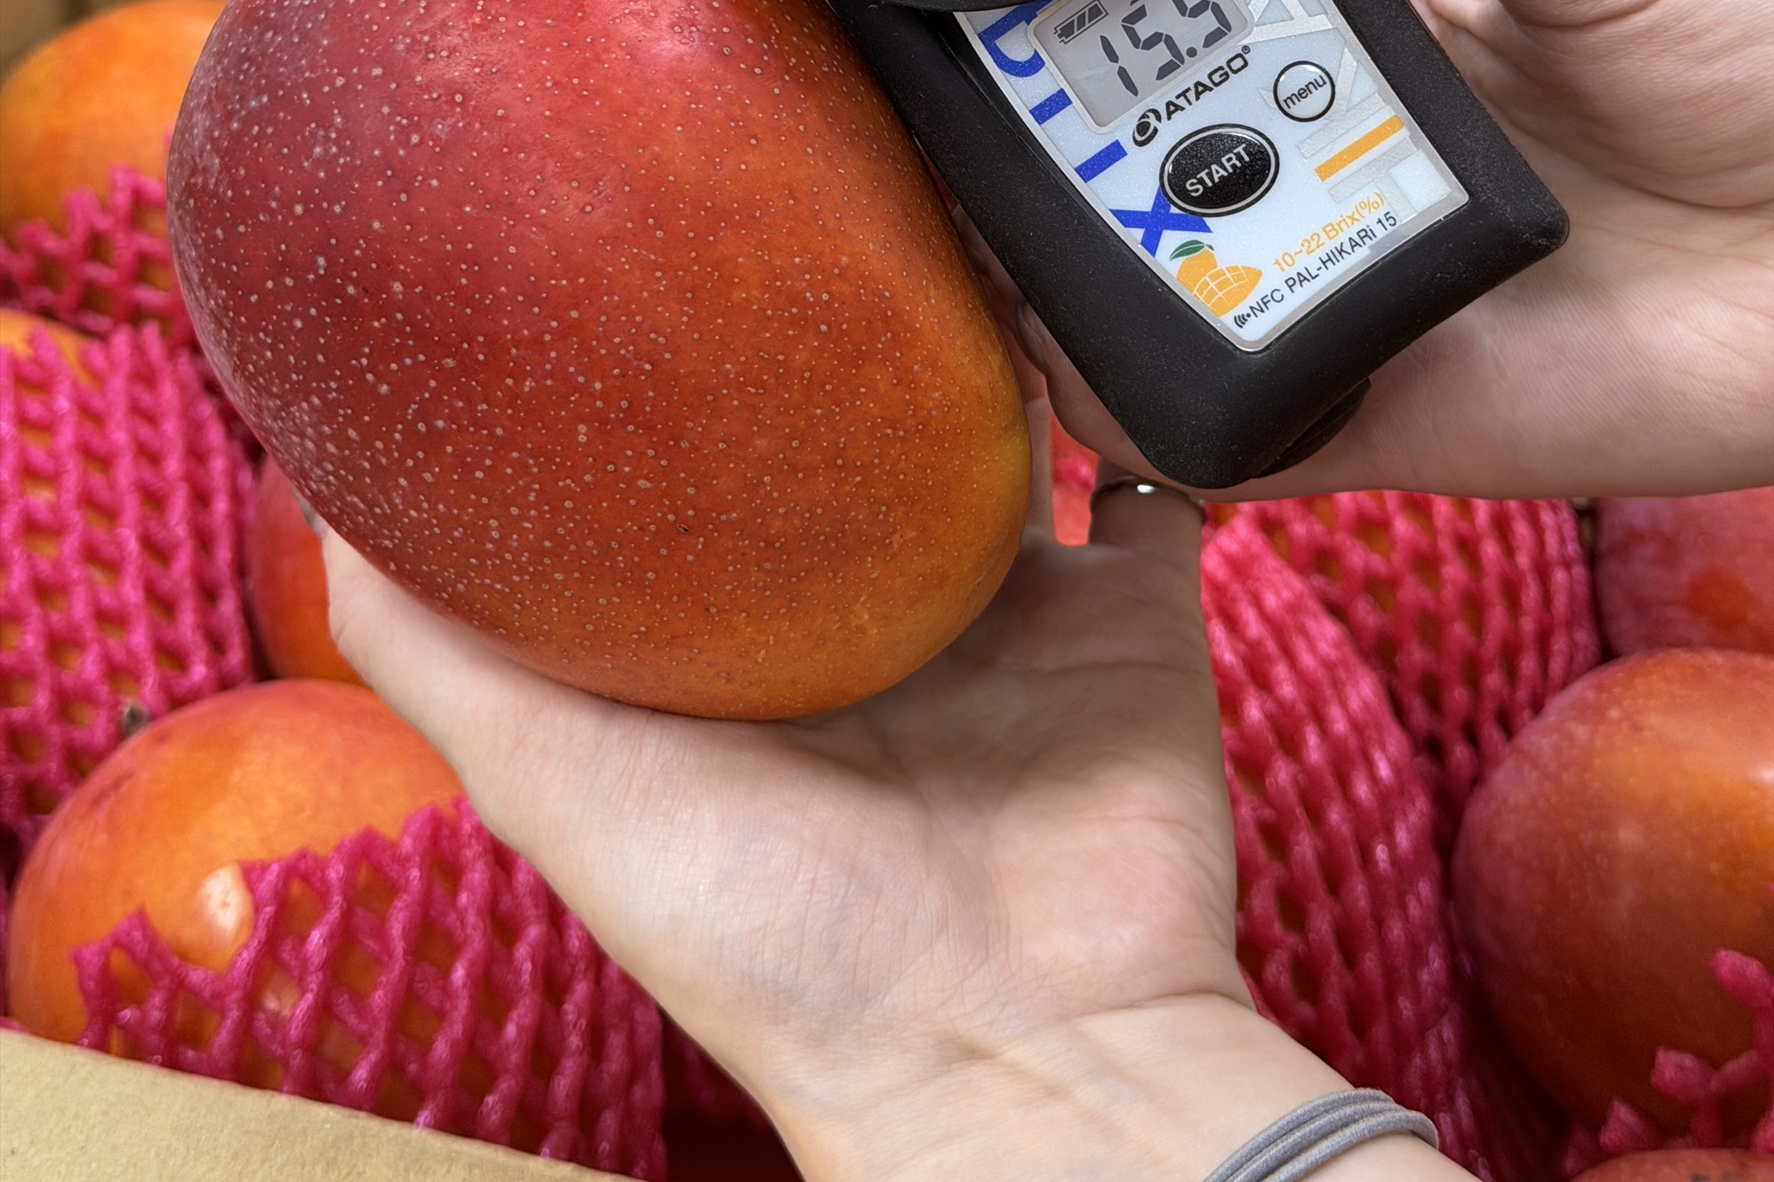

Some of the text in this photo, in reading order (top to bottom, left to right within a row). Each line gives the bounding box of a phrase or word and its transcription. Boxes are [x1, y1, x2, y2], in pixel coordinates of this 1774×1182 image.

[1283, 76, 1328, 110] menu
[1185, 145, 1251, 198] START
[1323, 192, 1385, 240] Brix(%)
[1250, 212, 1397, 317] NFC PAL-HIKARi 15
